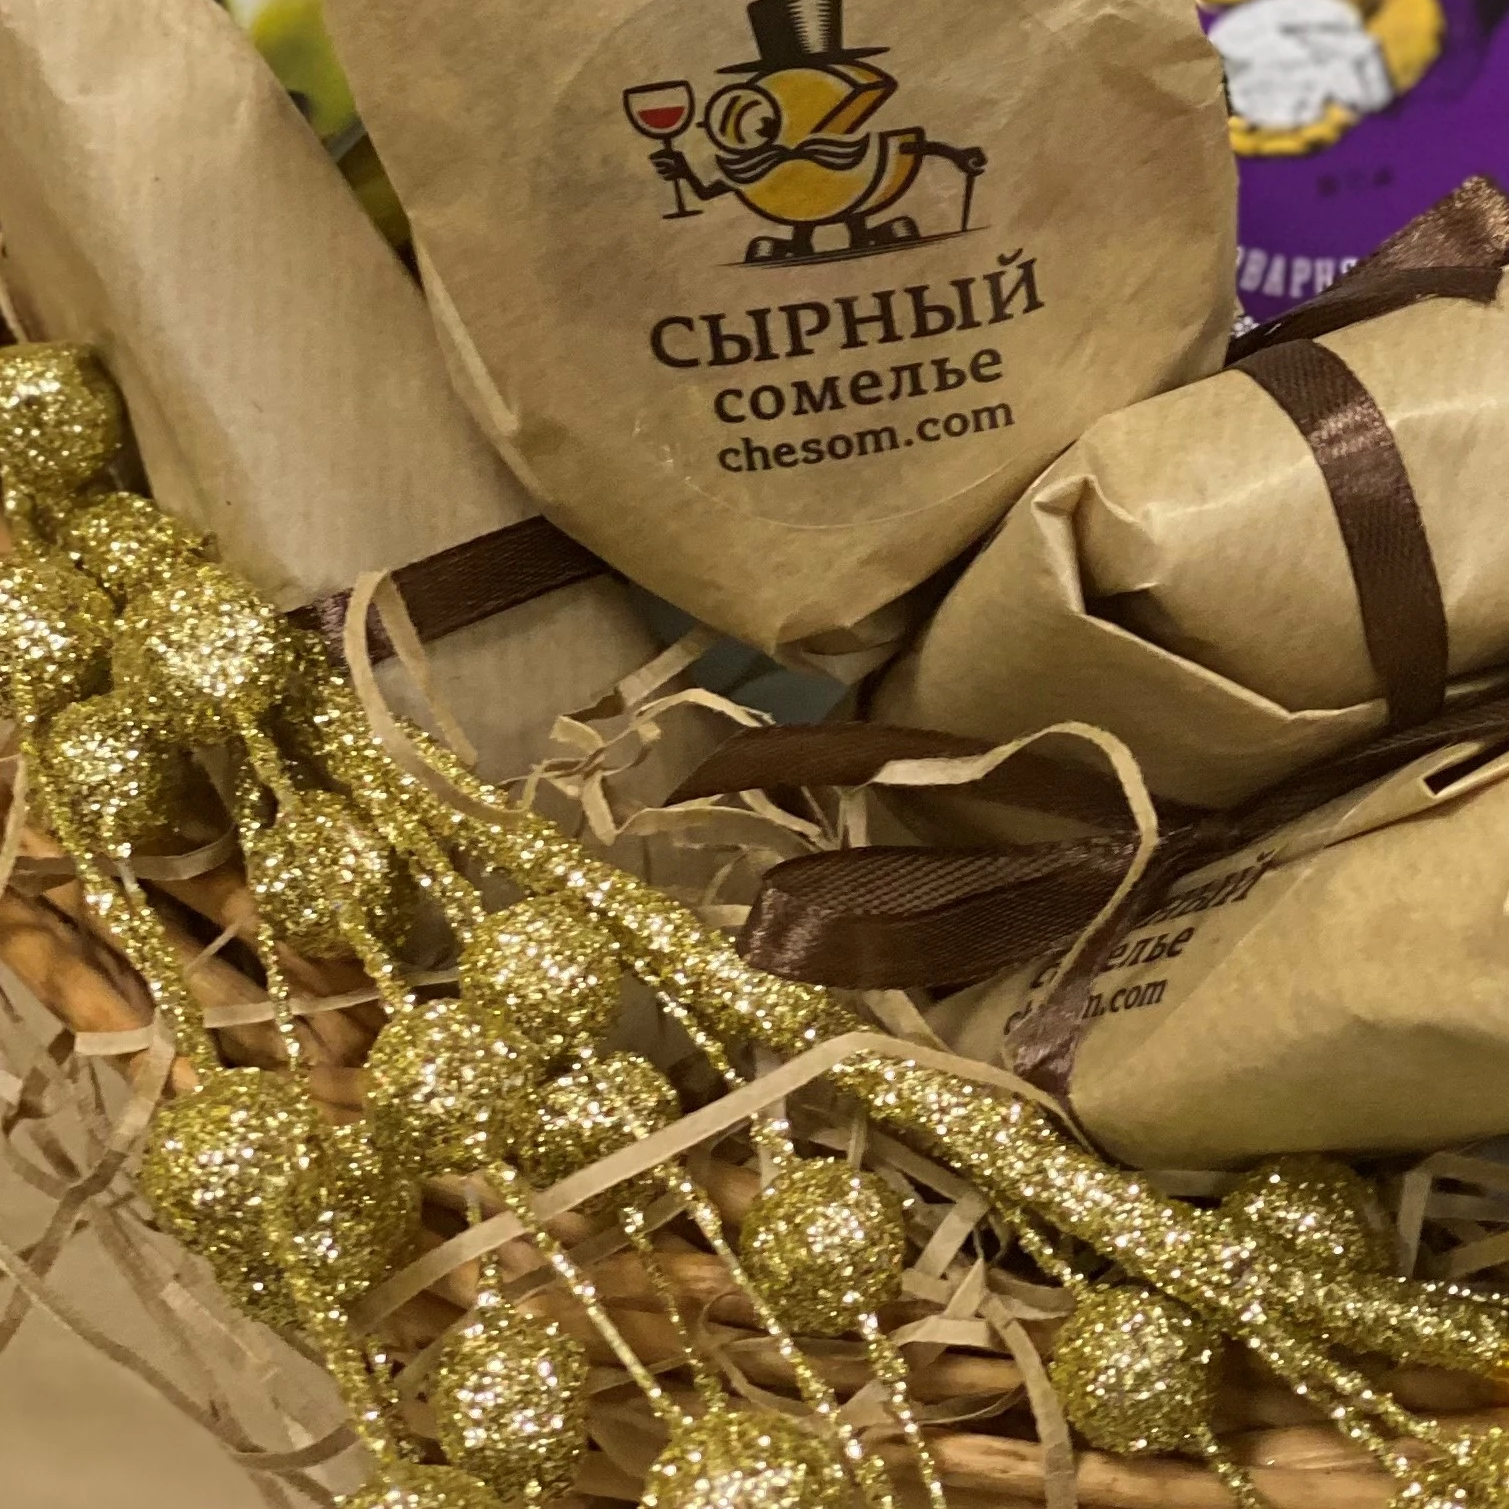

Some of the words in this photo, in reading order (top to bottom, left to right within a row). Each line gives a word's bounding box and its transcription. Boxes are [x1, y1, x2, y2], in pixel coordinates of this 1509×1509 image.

[650, 247, 1045, 369] СЫРНЫЙ
[1236, 247, 1358, 299] ВАРН
[713, 347, 1004, 423] сомелье
[716, 399, 1016, 473] chesom.com
